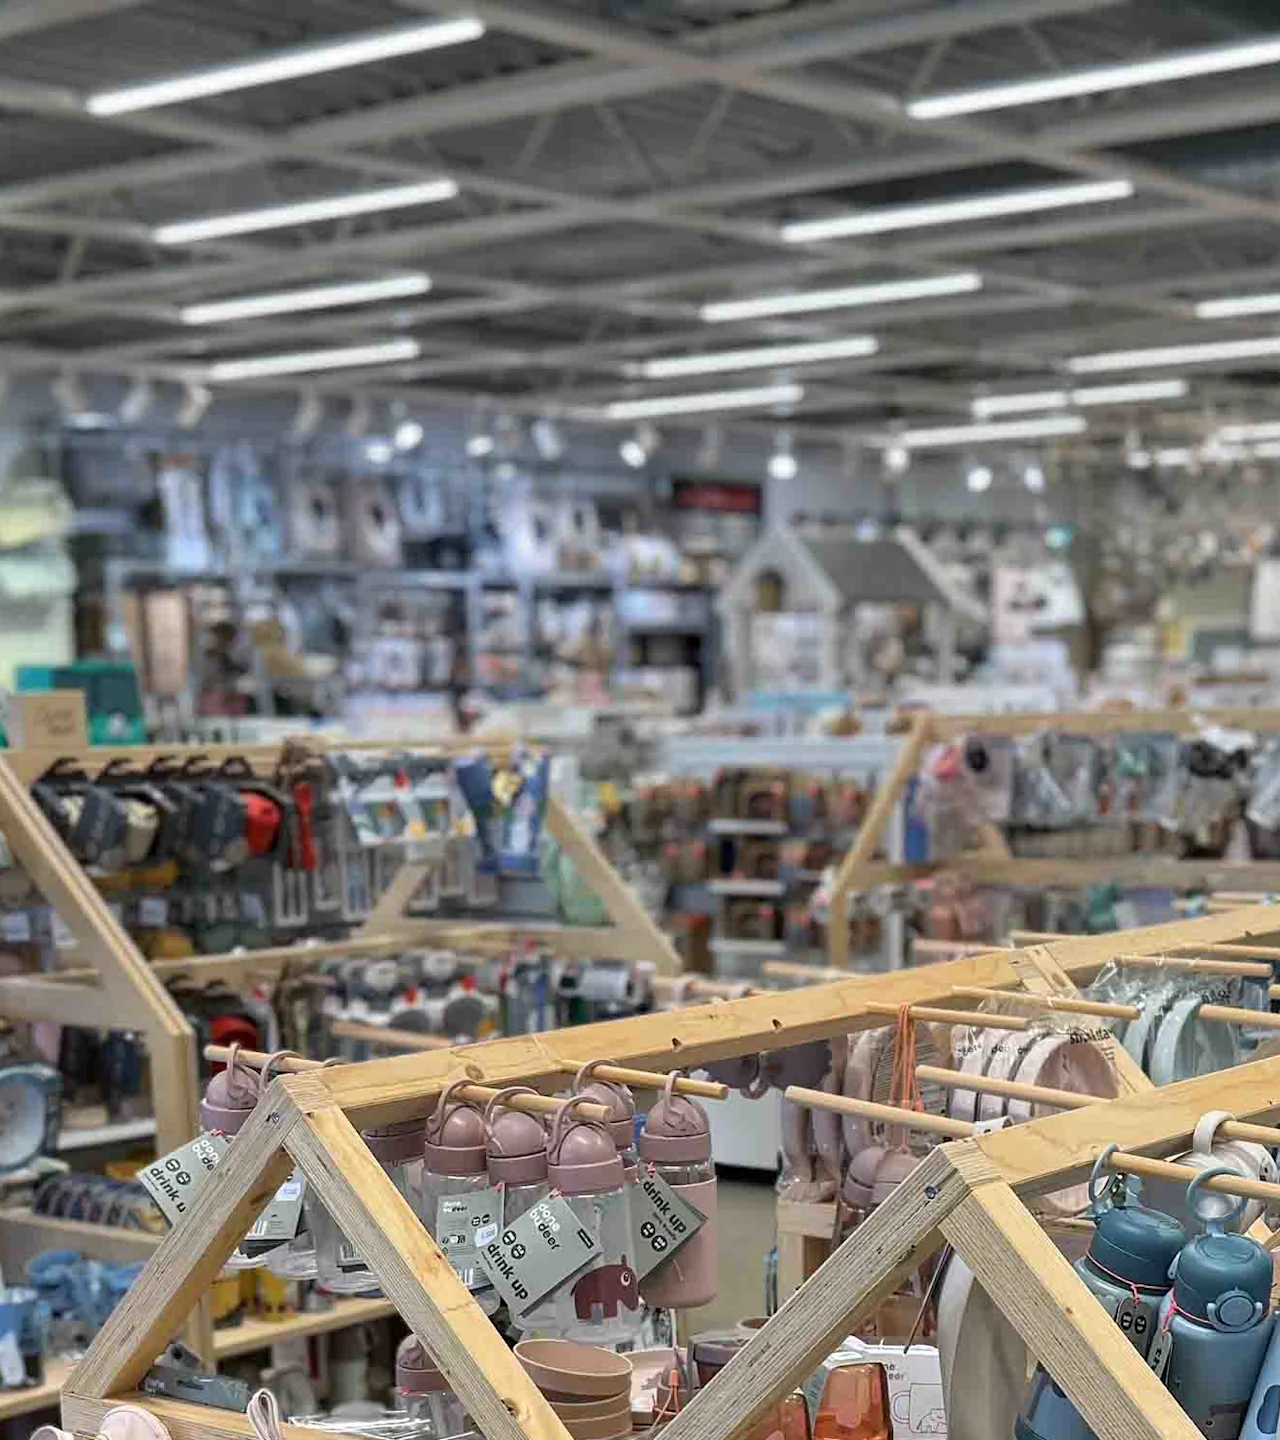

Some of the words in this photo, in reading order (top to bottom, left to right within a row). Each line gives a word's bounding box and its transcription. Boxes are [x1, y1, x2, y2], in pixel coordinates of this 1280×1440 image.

[150, 1167, 180, 1202] drink
[176, 1201, 188, 1213] u
[642, 1179, 674, 1218] drink
[668, 1215, 687, 1235] up
[538, 1202, 561, 1233] done
[487, 1243, 516, 1282] drink
[511, 1281, 529, 1301] up
